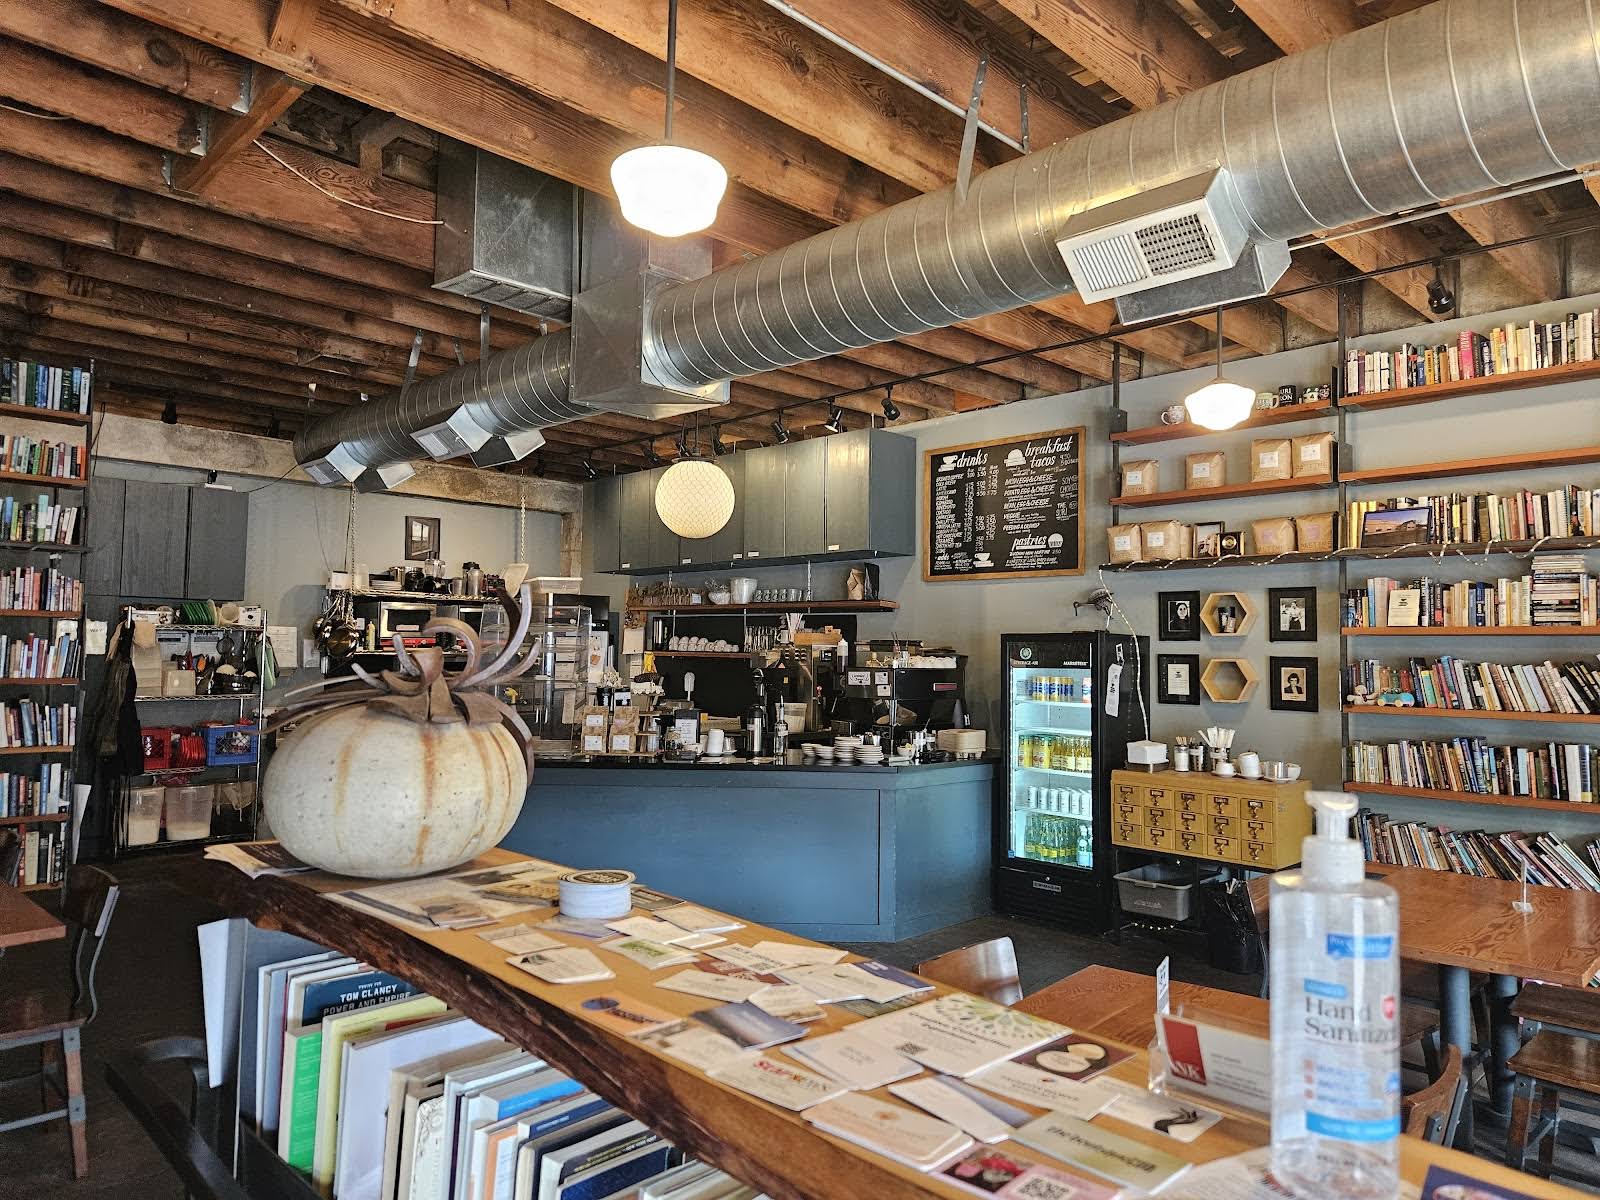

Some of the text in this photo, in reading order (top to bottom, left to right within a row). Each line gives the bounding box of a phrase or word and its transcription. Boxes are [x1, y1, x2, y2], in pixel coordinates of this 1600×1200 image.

[1025, 436, 1073, 457] breakfast
[957, 449, 988, 467] drinks
[1030, 453, 1056, 468] tacos
[1012, 533, 1047, 551] pastries
[340, 984, 398, 1003] TOM CLANCY
[323, 991, 411, 1016] POWER AND EMPIRE
[1304, 997, 1370, 1023] Hand
